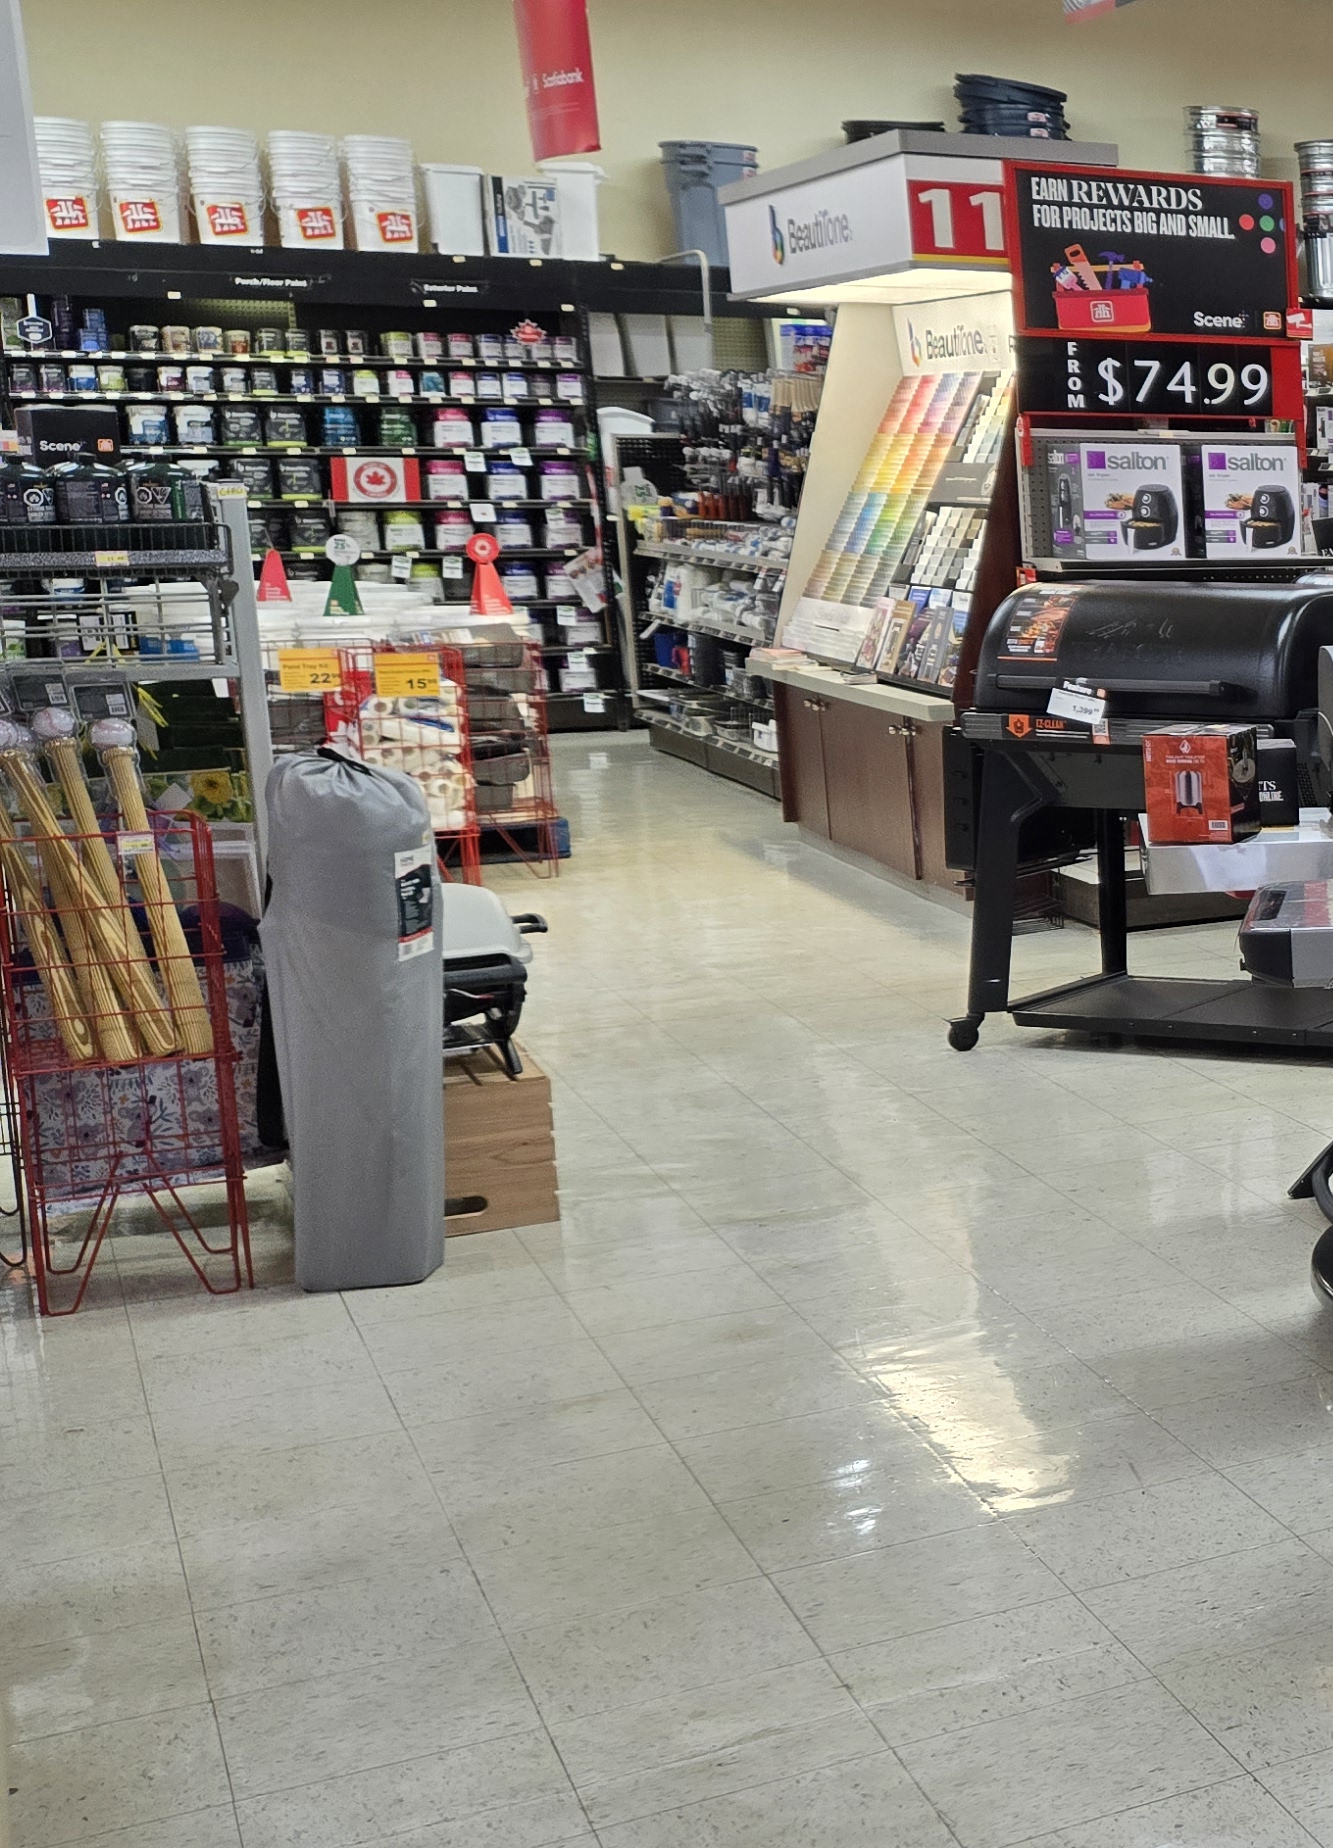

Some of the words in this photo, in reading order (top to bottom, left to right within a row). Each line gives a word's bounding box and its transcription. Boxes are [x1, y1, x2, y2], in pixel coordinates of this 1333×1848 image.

[1030, 176, 1069, 202] EARN
[1070, 179, 1203, 212] REWARDS
[787, 210, 850, 254] BeautiTone
[917, 188, 1005, 250] 11
[1032, 204, 1063, 228] FOR
[1063, 206, 1132, 234] PROJECTS
[1134, 211, 1158, 233] BIG
[1159, 214, 1187, 236] AND
[1187, 215, 1236, 239] SMALL.
[1066, 341, 1086, 409] FROM
[1097, 356, 1269, 406] $74.99
[1106, 451, 1167, 470] salton
[1227, 452, 1284, 471] salton
